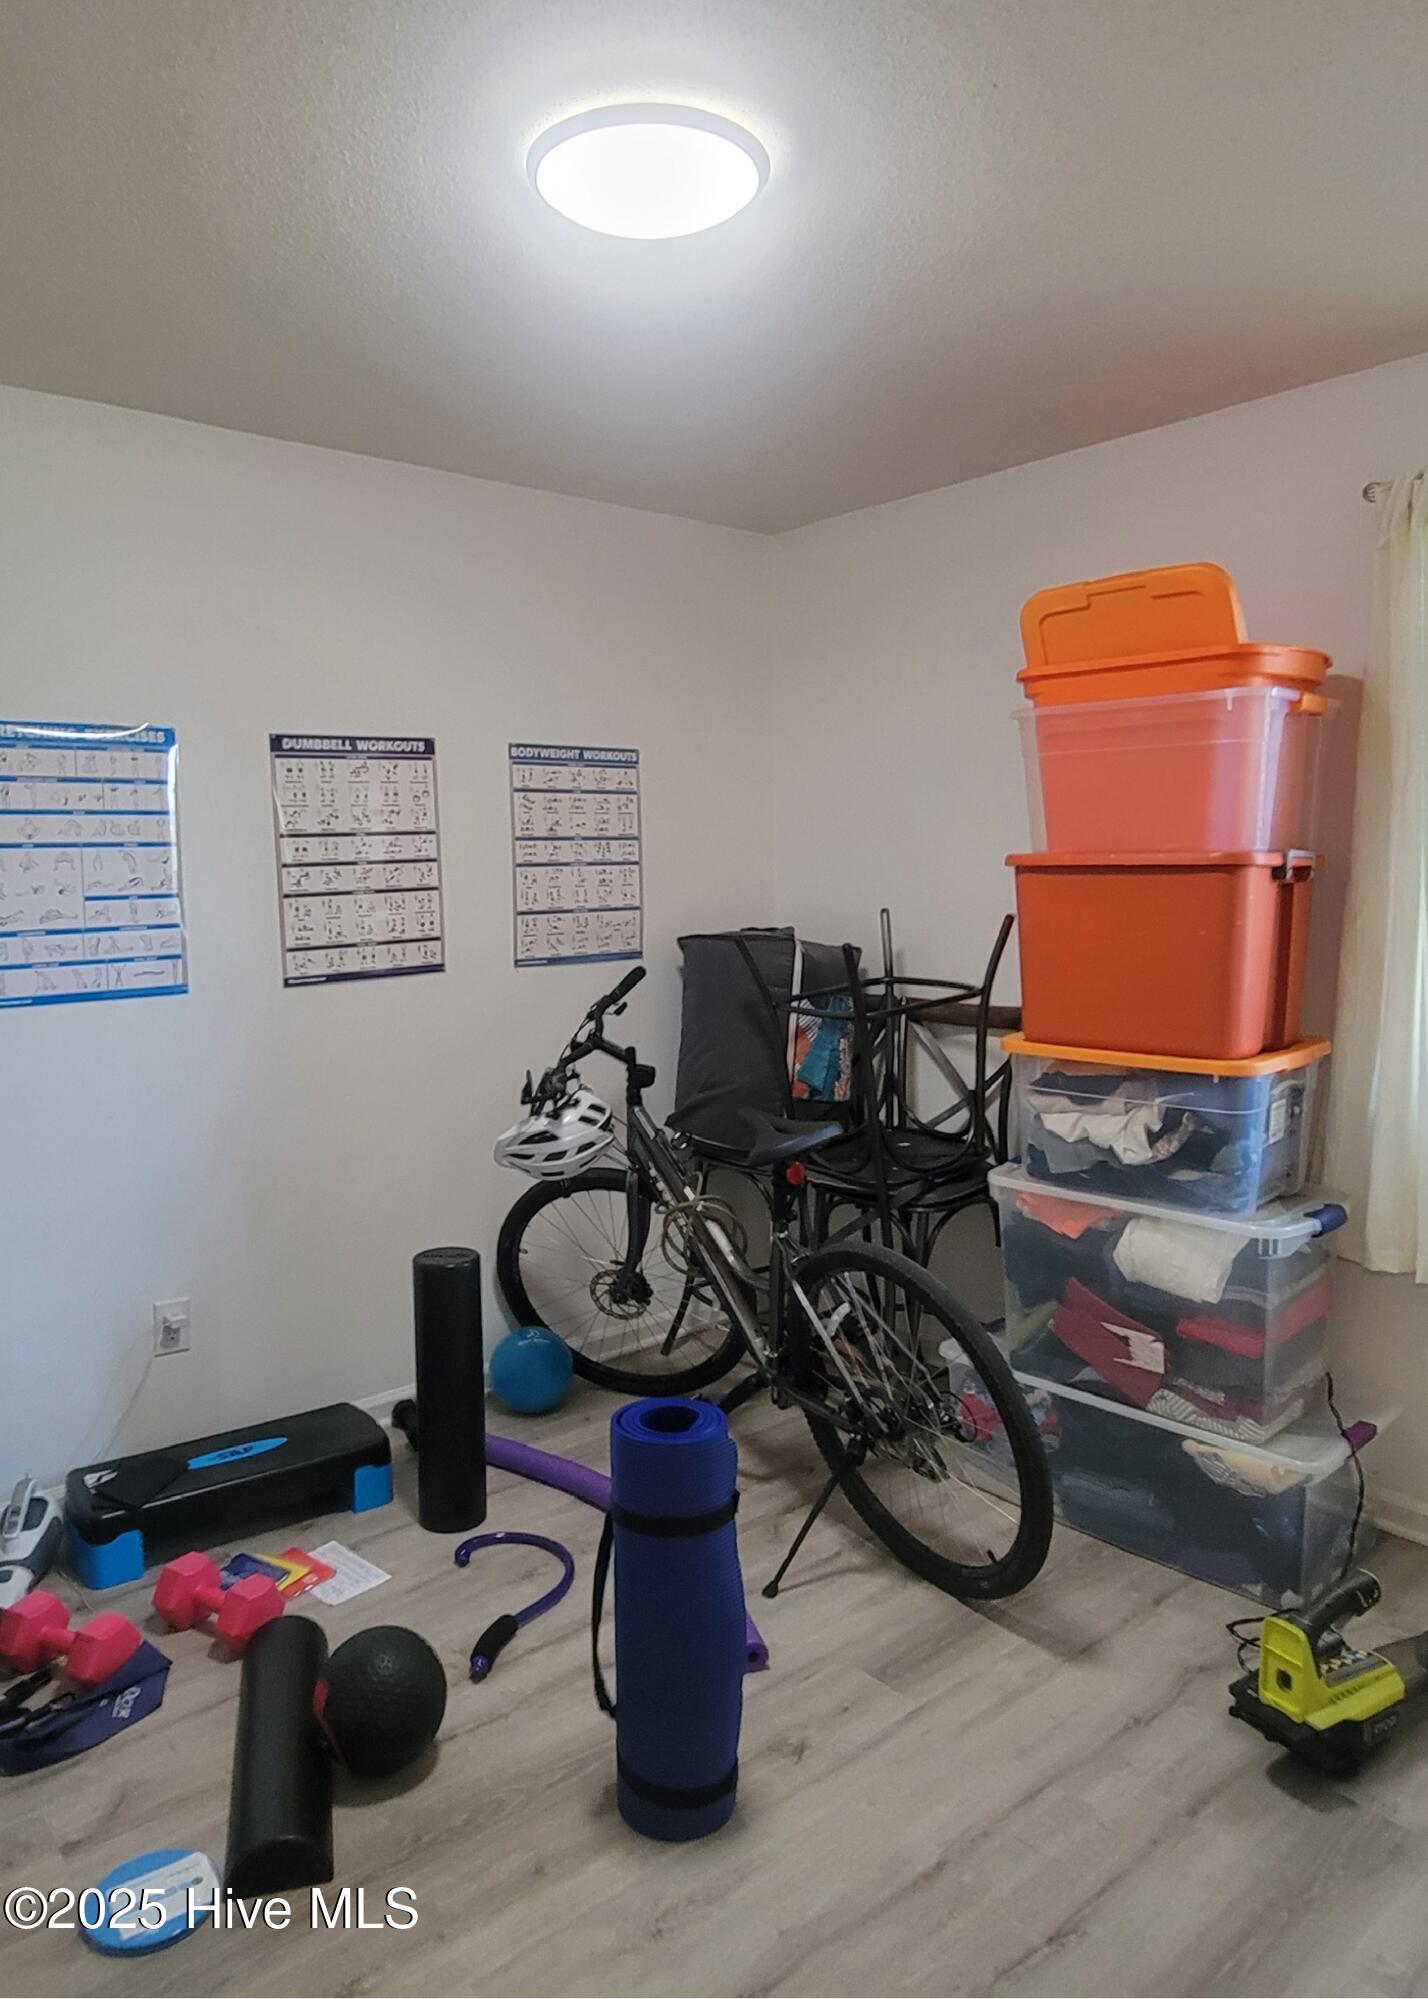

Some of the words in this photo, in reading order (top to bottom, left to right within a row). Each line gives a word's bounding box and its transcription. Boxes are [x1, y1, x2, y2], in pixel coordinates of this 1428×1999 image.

[282, 738, 352, 750] DUMBBELL
[356, 740, 425, 752] WORKOUTS
[511, 747, 581, 760] BODYWEIGHT
[583, 750, 637, 762] WORKOUTS
